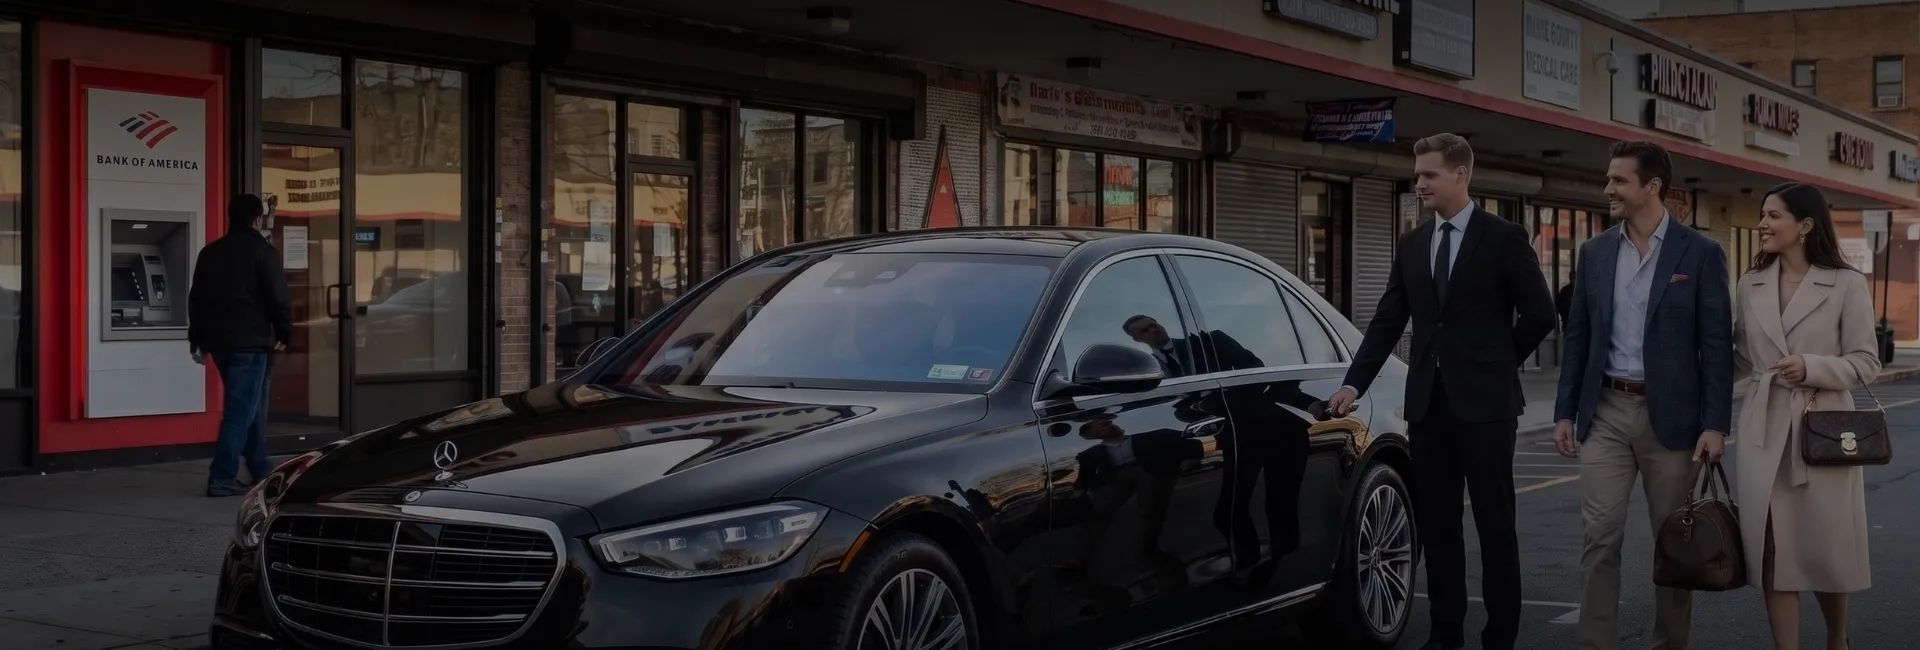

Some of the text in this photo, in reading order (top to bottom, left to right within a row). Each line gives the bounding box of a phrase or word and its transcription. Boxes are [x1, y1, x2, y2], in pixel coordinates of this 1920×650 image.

[1526, 50, 1578, 86] MEDICAL CARE
[97, 155, 198, 170] BANK OF AMERICA
